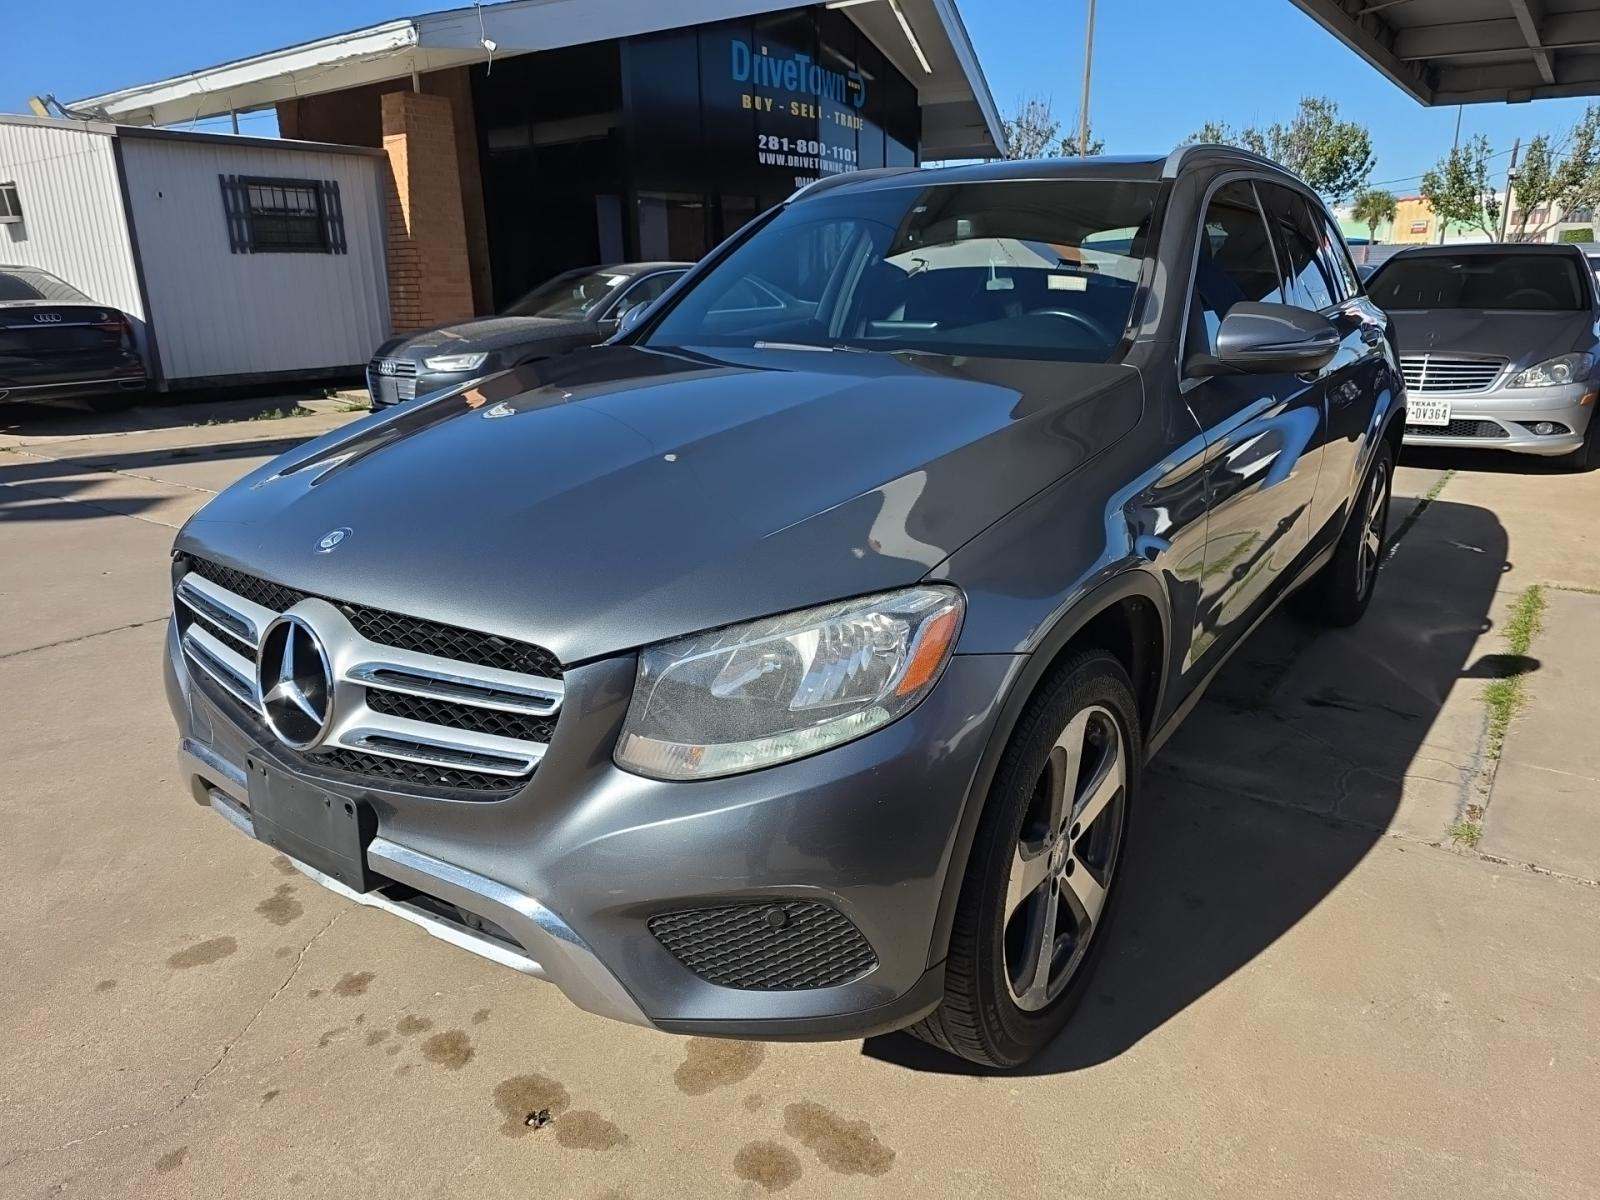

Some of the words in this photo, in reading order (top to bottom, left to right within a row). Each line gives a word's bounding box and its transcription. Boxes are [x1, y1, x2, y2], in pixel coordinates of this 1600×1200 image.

[732, 39, 846, 103] DriveTown
[742, 94, 773, 112] BUY
[834, 111, 863, 131] TRADE
